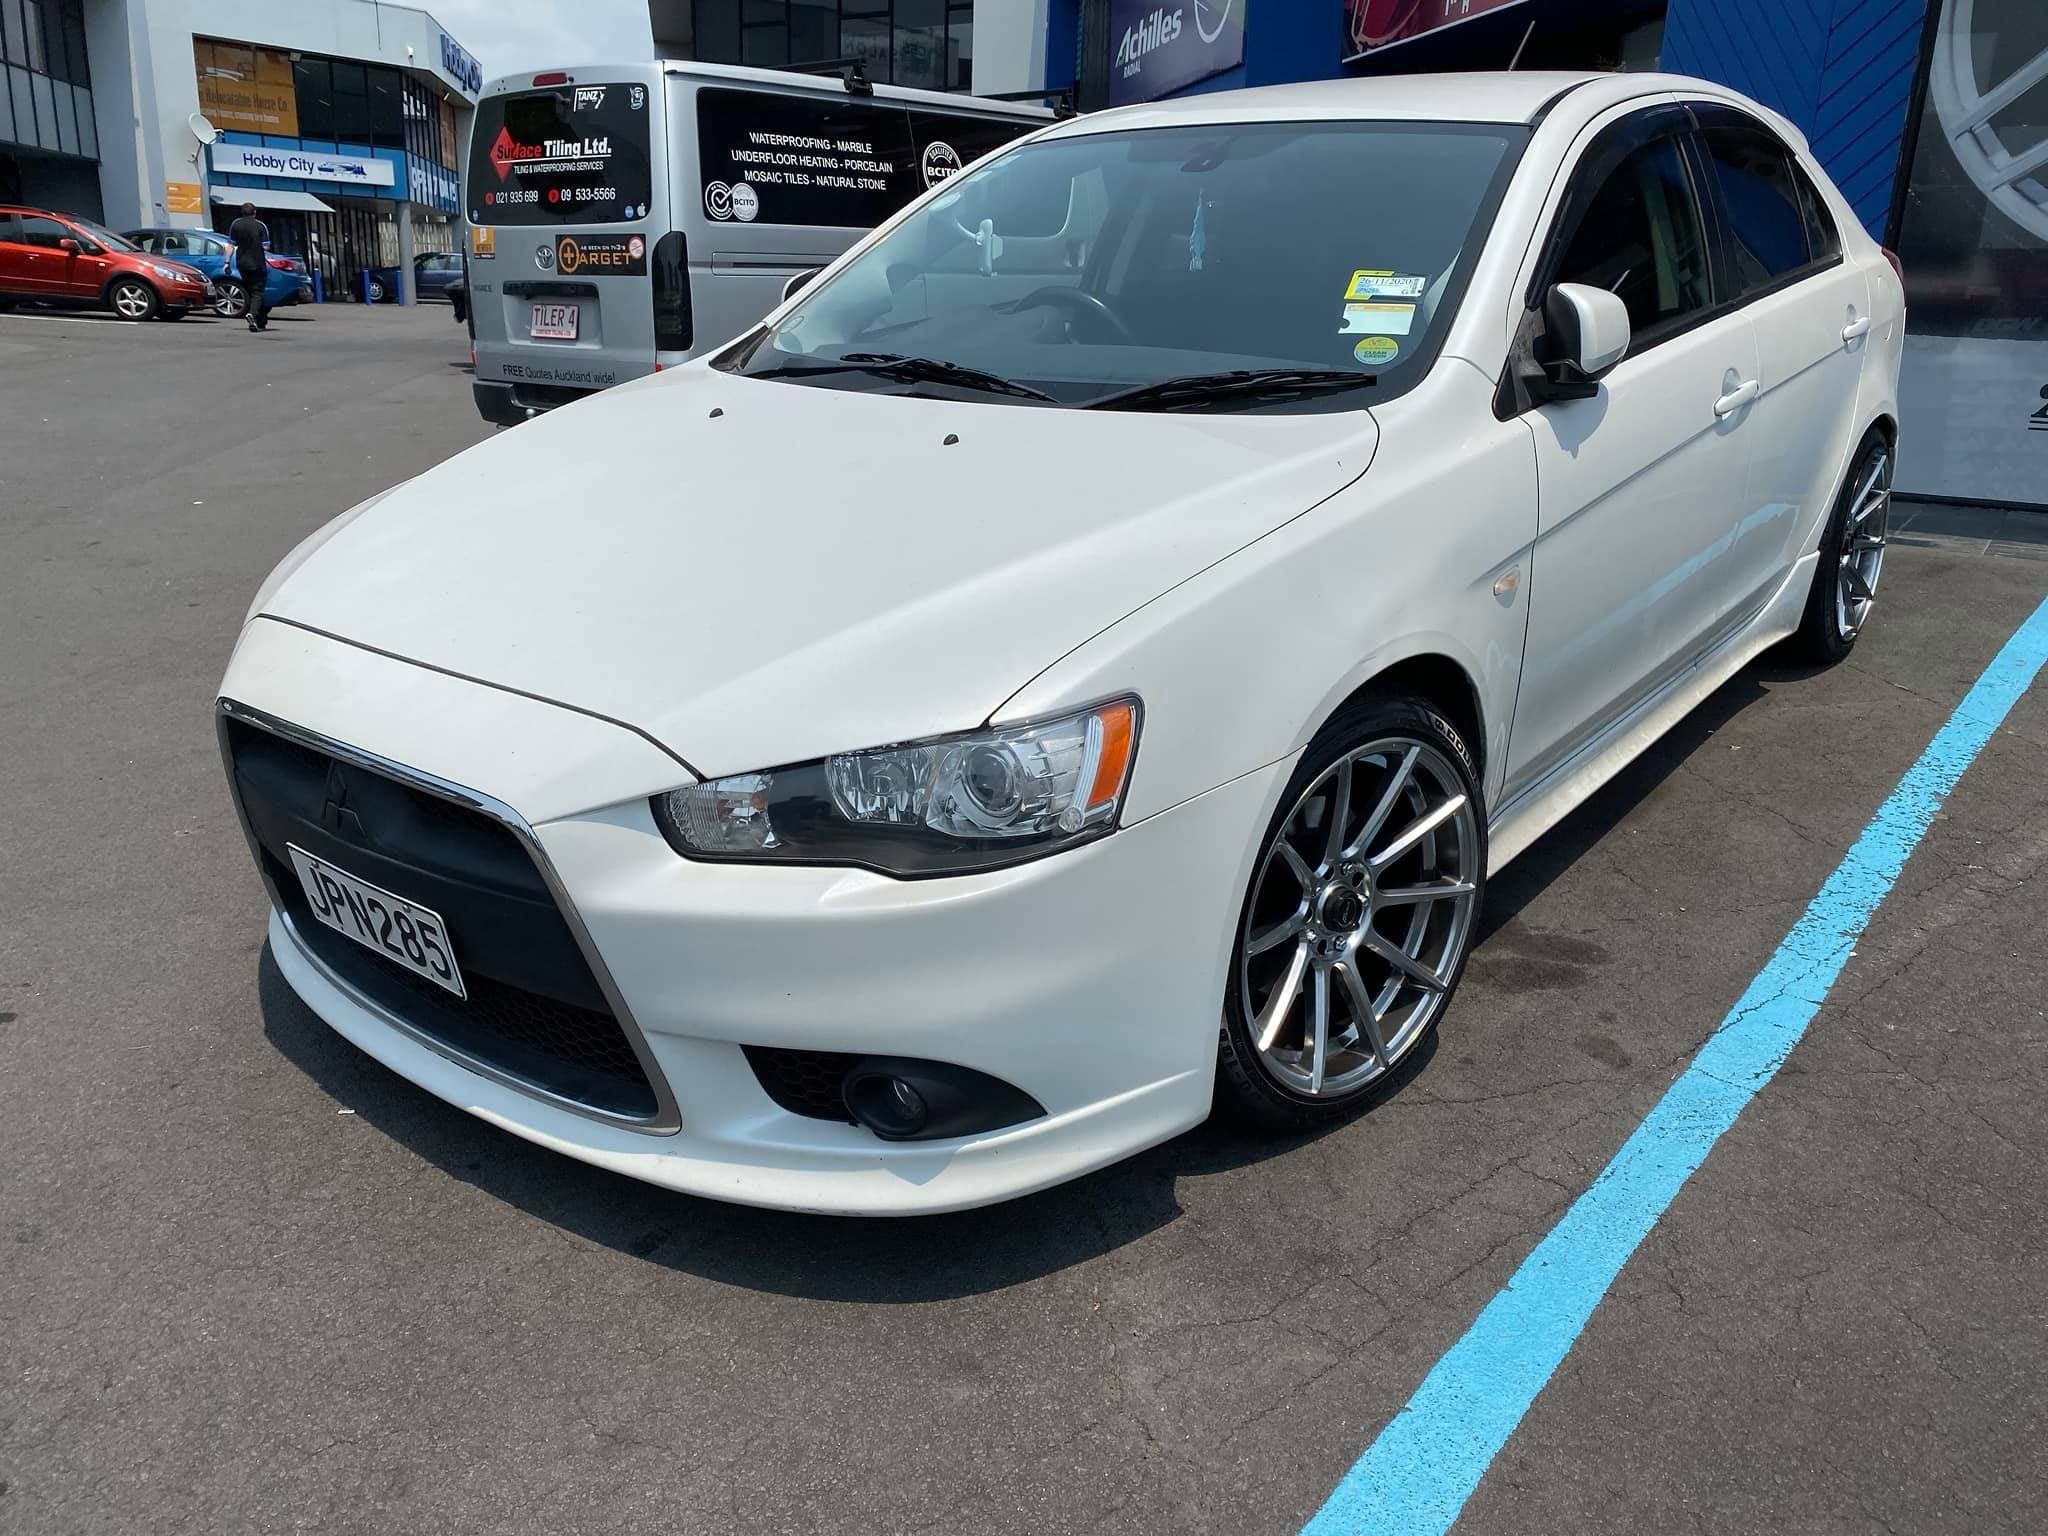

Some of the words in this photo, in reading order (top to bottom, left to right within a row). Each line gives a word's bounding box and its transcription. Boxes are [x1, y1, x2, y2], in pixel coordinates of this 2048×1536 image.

[1115, 8, 1183, 68] Achilles
[1124, 61, 1141, 79] RADIAL
[496, 143, 542, 159] Surface
[543, 139, 581, 159] Tiling
[584, 137, 612, 154] Ltd.
[749, 132, 831, 150] WATERPROOFING
[837, 140, 872, 154] MARBLE
[243, 153, 285, 172] Hobby
[288, 157, 315, 175] City
[514, 165, 529, 174] TILING
[533, 163, 576, 173] WATERPROOFING
[576, 161, 604, 172] SERVICES
[731, 150, 798, 165] UNDERFLOOR
[799, 155, 838, 169] HEATING
[845, 159, 893, 173] PORCELAIN
[744, 170, 782, 183] MOSAIC
[783, 173, 809, 185] TILES
[816, 176, 857, 188] NATURAL
[857, 178, 886, 190] STONE
[495, 192, 508, 203] 021
[509, 191, 524, 203] 935
[524, 190, 539, 202] 699
[561, 189, 572, 201] 09
[575, 187, 616, 201] 533-5566
[1360, 277, 1412, 285] 26/11/2020
[534, 308, 564, 326] TILER
[569, 309, 575, 327] 4
[503, 365, 524, 377] FREE
[525, 367, 553, 380] Quotes
[554, 369, 592, 383] Auckland
[594, 371, 616, 384] wide!
[309, 866, 452, 980] JPN285
